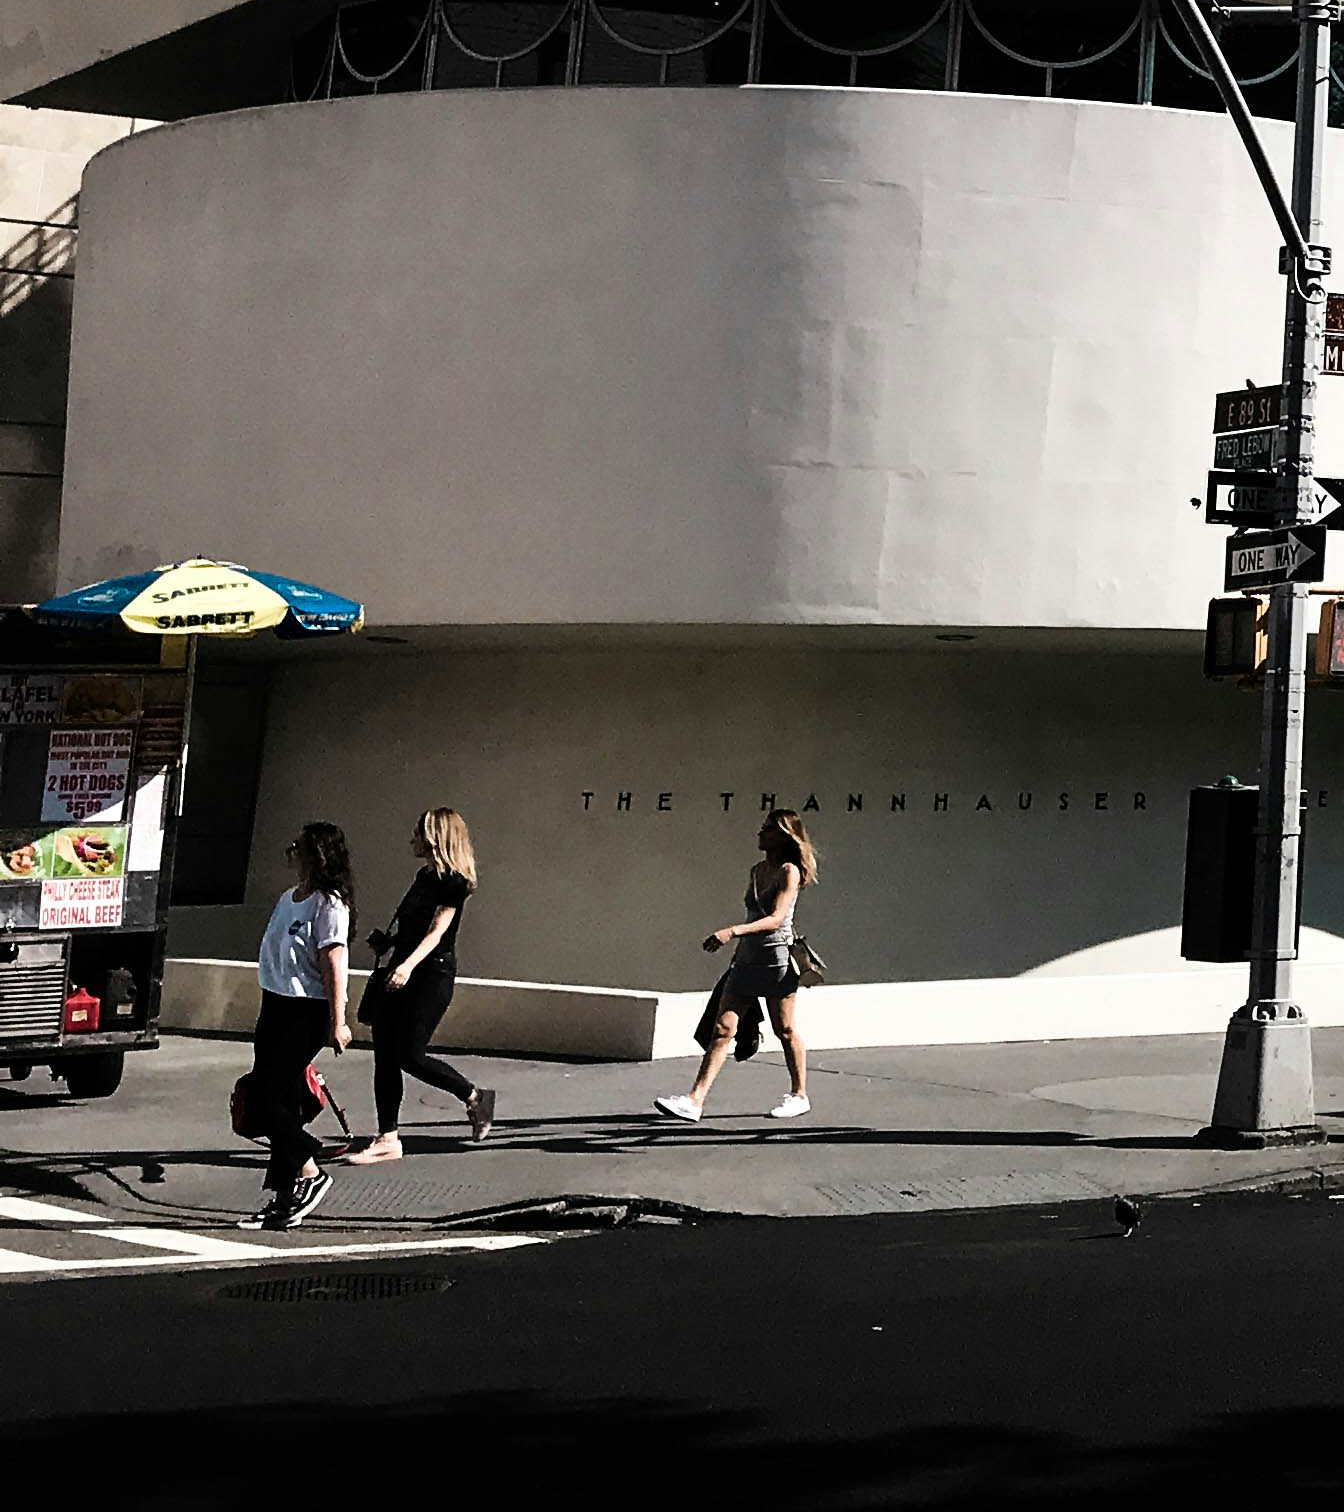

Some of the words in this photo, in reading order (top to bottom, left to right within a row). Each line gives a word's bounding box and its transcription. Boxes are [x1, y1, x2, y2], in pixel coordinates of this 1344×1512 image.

[1228, 402, 1236, 427] E
[1239, 400, 1254, 425] 89
[1258, 396, 1271, 424] St
[1227, 488, 1267, 510] ONE
[1238, 549, 1265, 572] ONE
[1275, 544, 1301, 568] WAY
[157, 610, 255, 630] SABRETT
[48, 775, 57, 791] 2
[60, 775, 87, 791] HOT
[89, 774, 125, 791] DOGS
[582, 793, 673, 812] THE
[720, 792, 1147, 812] THANNHAUSER
[43, 906, 91, 926] ORIGINAL
[95, 905, 121, 924] BEEF
